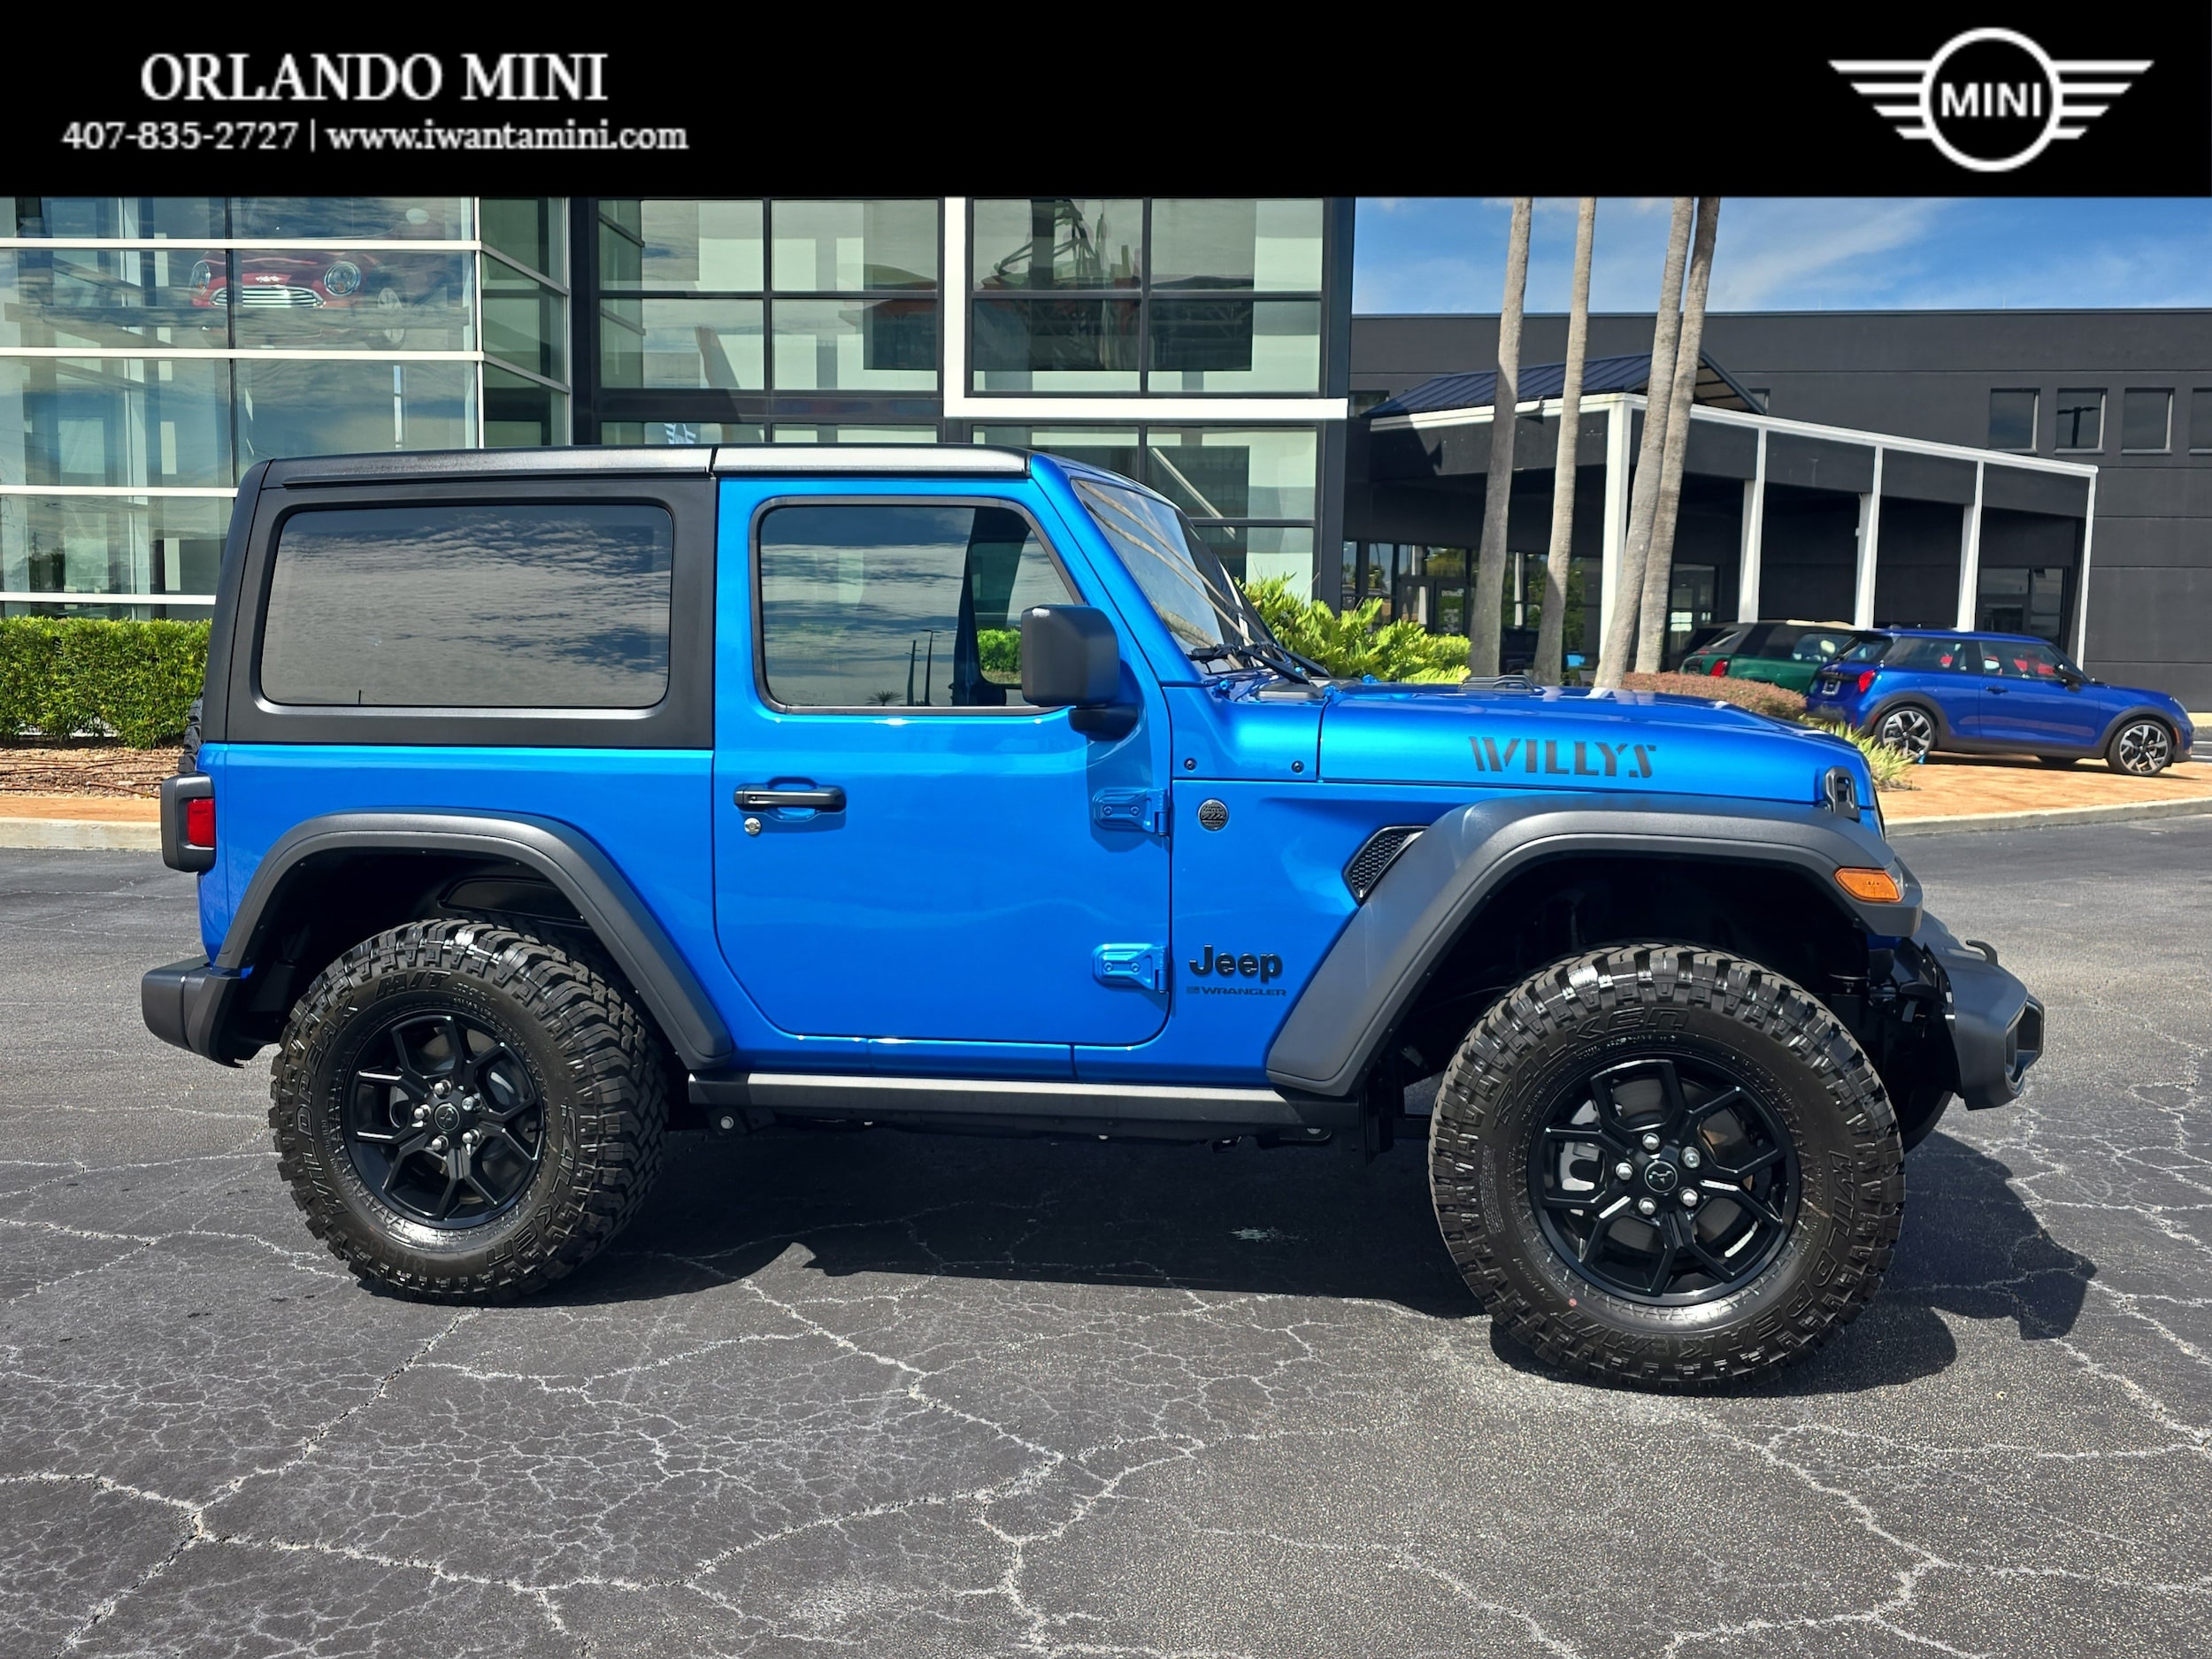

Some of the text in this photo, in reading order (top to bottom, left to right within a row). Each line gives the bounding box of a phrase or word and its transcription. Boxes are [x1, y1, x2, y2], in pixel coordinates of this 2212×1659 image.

[1468, 735, 1658, 779] WILLYS
[1188, 943, 1283, 984] Jeep
[1201, 986, 1287, 996] WRANGLER
[1492, 1006, 1691, 1130] FALKEN
